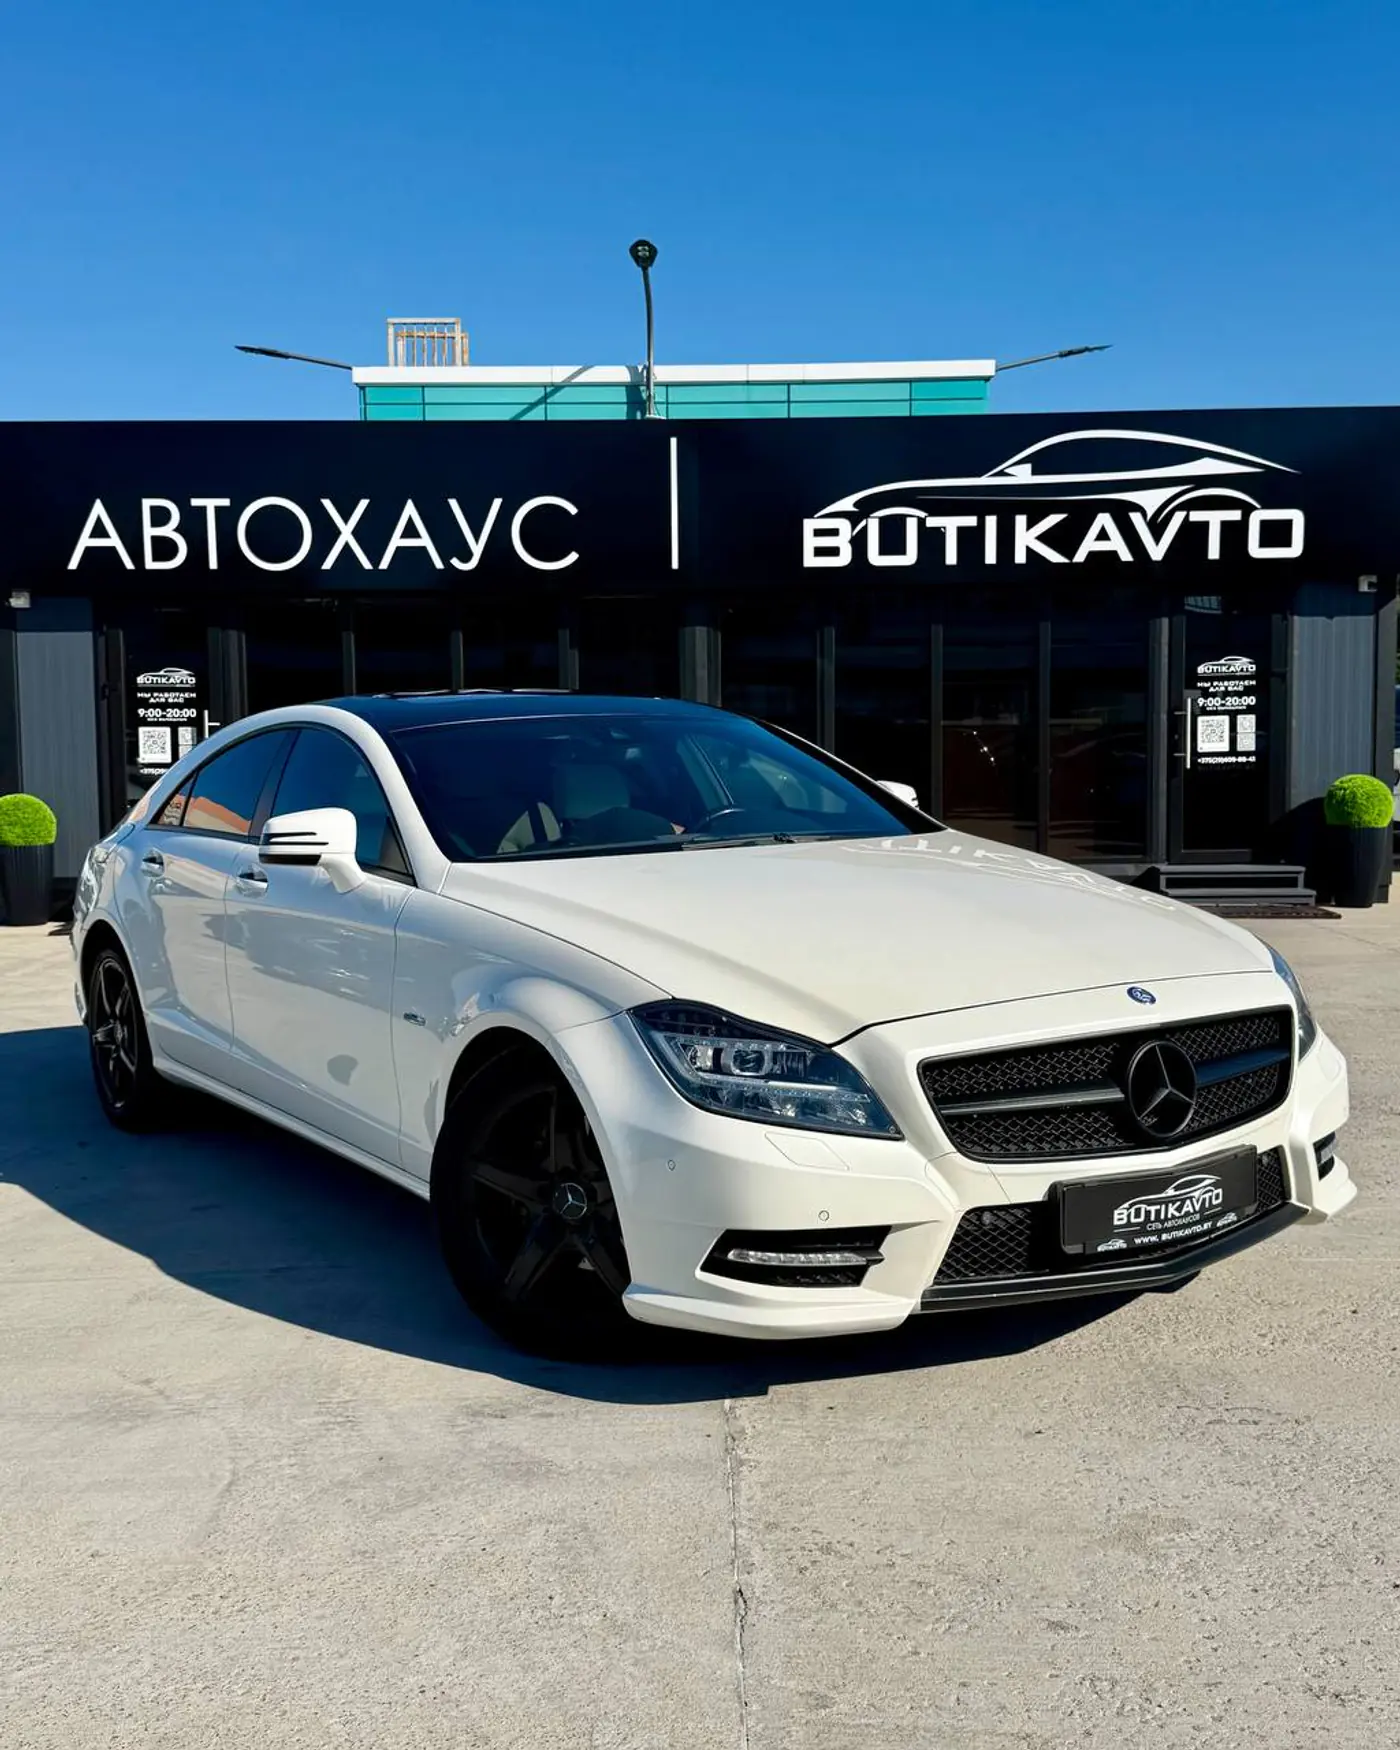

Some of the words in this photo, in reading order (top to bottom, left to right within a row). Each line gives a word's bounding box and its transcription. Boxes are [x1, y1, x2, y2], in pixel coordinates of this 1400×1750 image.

[67, 496, 580, 572] АВТОХАУС
[803, 508, 1304, 567] BUTIKAVTO
[1197, 664, 1256, 674] BUTIKAVTO
[136, 676, 196, 684] BUTIKAVTO
[1197, 696, 1256, 706] 9:00-20:00
[137, 708, 197, 718] 9:00-20:00
[1113, 1188, 1223, 1226] BUTIKAVTO
